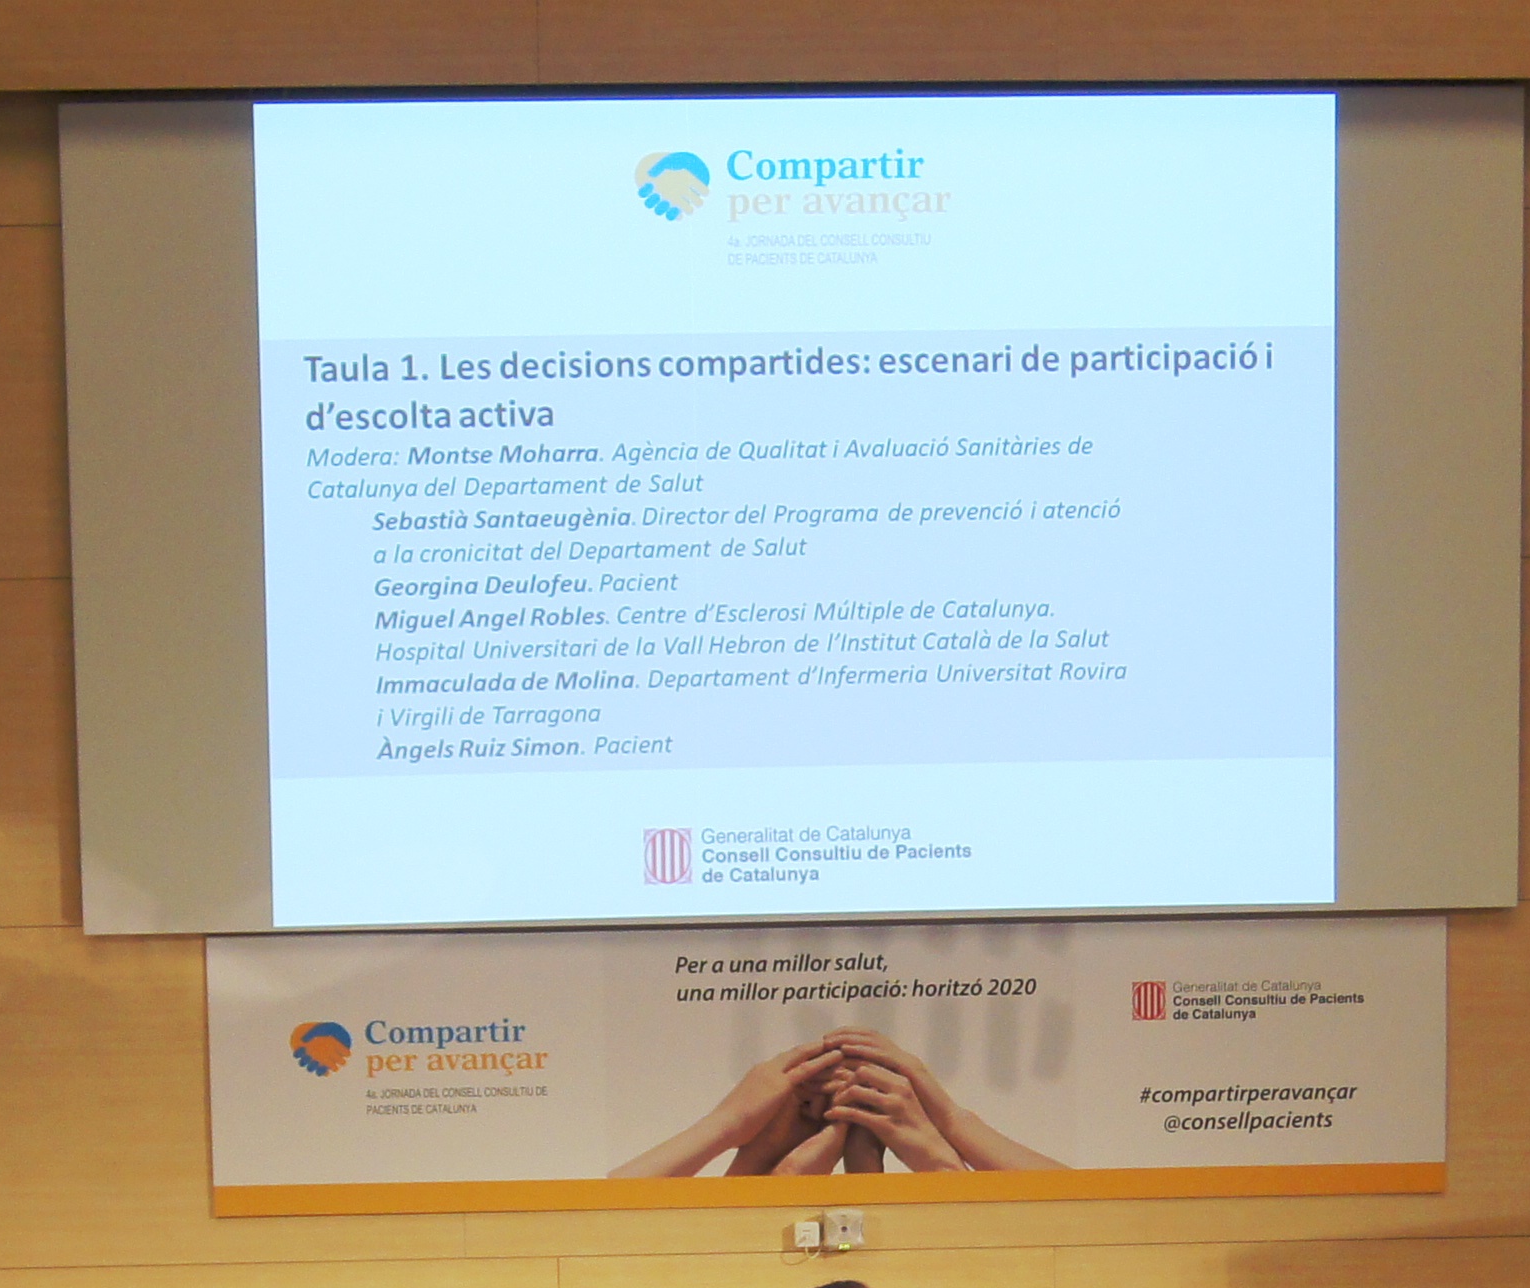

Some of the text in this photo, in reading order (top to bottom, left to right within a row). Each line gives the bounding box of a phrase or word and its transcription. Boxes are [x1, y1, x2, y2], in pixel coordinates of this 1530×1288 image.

[726, 148, 924, 186] Compartir
[727, 192, 951, 222] per avançar
[303, 341, 1271, 382] Taula 1. Les decisions compartides: escenari de participació i
[459, 399, 553, 428] activa
[306, 435, 1093, 466] Modera: Montse Moharra. Agència de Qualitat i Avaluació Sanitàries de
[307, 472, 703, 502] Catalunya del Departament de Salut
[372, 497, 1120, 531] Sebastià Santaeugènia. Director del Programa de prevenció i atenció
[373, 536, 807, 563] a la cronicitat del Departament de Salut
[374, 573, 678, 600] Georgina Deulofeu. Pacient
[374, 608, 455, 633] Miguel
[458, 607, 525, 631] Angel
[529, 605, 609, 626] Robles.
[616, 605, 686, 624] Centre
[813, 599, 904, 624] Múltiple
[909, 599, 935, 619] de
[942, 598, 1053, 625] Catalunya.
[375, 640, 465, 665] Hospital
[473, 638, 597, 659] Universitari
[603, 636, 629, 656] de
[635, 636, 655, 655] la
[663, 635, 703, 655] Vall
[708, 634, 785, 654] Hebron
[793, 633, 819, 652] de
[922, 628, 991, 650] Català
[997, 629, 1022, 649] de
[1028, 628, 1048, 648] la
[1054, 628, 1109, 648] Salut
[376, 672, 516, 694] Immaculada
[521, 671, 548, 690] de
[554, 669, 639, 690] Molina.
[647, 668, 789, 692] Departament
[936, 663, 1052, 682] Universitat
[1059, 661, 1127, 680] Rovira
[376, 705, 601, 730] i Virgili de Tarragona
[376, 735, 673, 763] Àngels Ruiz Simon. Pacient
[700, 825, 911, 845] Generalitat de Catalunya
[701, 843, 971, 863] Consell Consultiu de Pacients
[701, 866, 819, 884] de Catalunya
[674, 952, 887, 973] Per a una millor salut,
[676, 978, 1036, 1004] una millor participació: horitzó 2020
[1172, 979, 1321, 996] Generalitat de Catalunya
[1172, 992, 1364, 1007] Consell Consultiu de Pacients
[1172, 1008, 1255, 1021] de Catalunya
[364, 1018, 525, 1049] Compartir
[365, 1052, 548, 1078] per avançar
[1139, 1084, 1357, 1106] #compartirperavançar
[1163, 1110, 1332, 1133] @consellpacients
